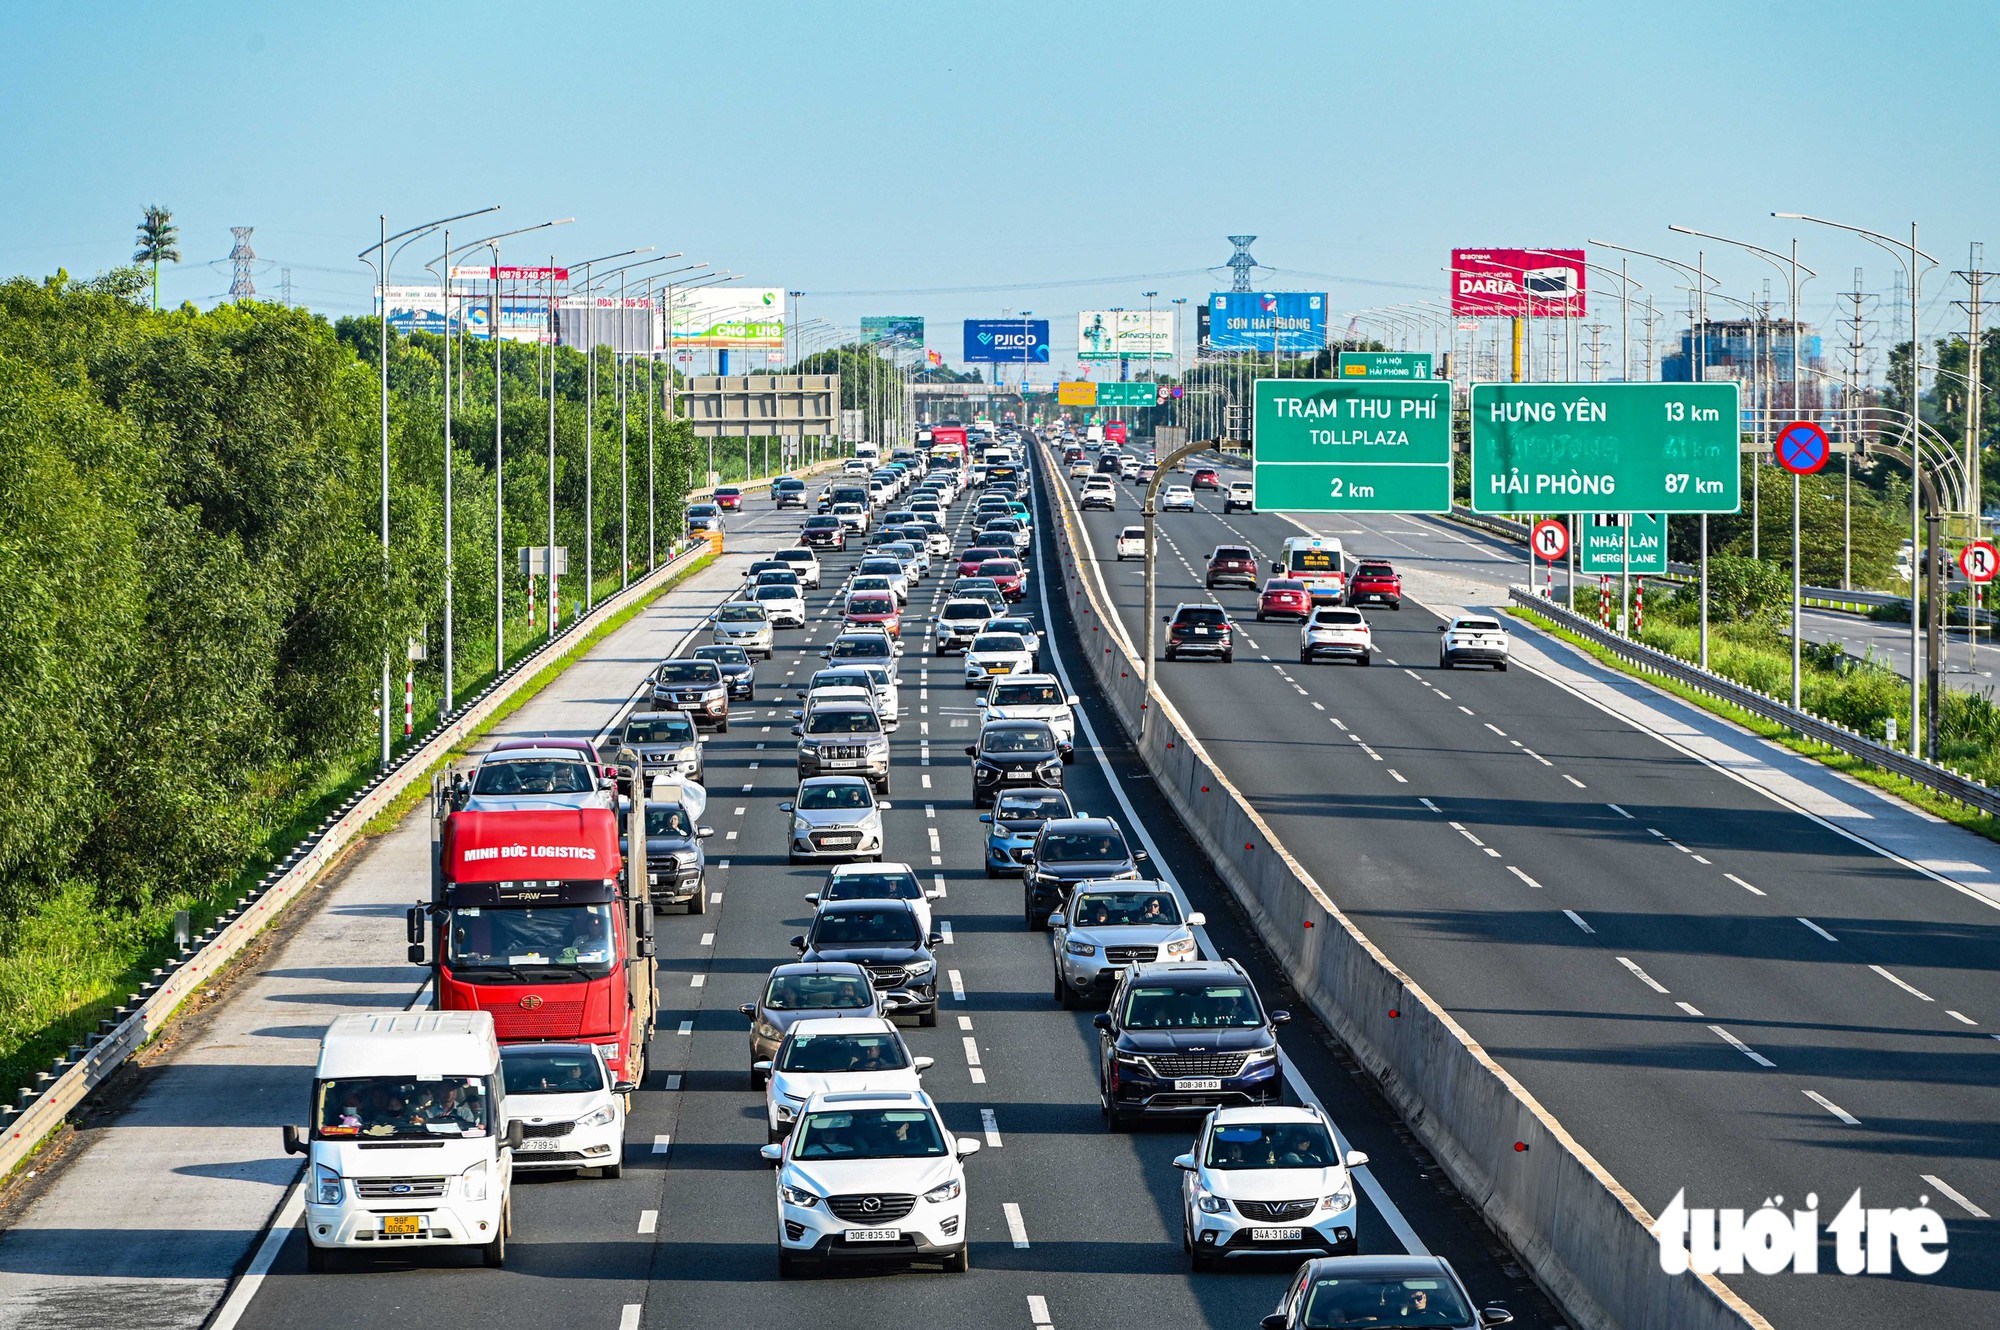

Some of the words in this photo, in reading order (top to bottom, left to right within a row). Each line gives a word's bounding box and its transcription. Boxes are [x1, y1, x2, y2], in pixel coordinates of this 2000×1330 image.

[1460, 280, 1517, 294] DARIA
[1227, 317, 1248, 330] SƠN
[716, 326, 746, 336] CNG
[994, 334, 1036, 346] PJICO
[1389, 358, 1402, 366] NỘI
[1370, 366, 1382, 376] HẢI
[1384, 366, 1409, 376] PHÒNG
[1274, 398, 1337, 422] TRẠM
[1346, 399, 1391, 419] THU
[1401, 394, 1438, 419] PHÍ
[1490, 400, 1556, 422] HƯNG
[1562, 396, 1606, 422] YÊN
[1664, 402, 1684, 421] 13
[1692, 404, 1719, 421] km
[1310, 430, 1409, 446] TOLLPLAZA
[1490, 468, 1529, 494] HẢI
[1536, 469, 1615, 494] PHÒNG
[1664, 474, 1689, 494] 87
[1696, 477, 1724, 494] km
[1330, 478, 1343, 498] 2
[1350, 483, 1374, 498] km
[1630, 532, 1658, 548] LÀN
[1630, 554, 1656, 562] LANE
[464, 848, 498, 862] MINH
[501, 843, 528, 858] ĐỨC
[530, 846, 596, 860] LOGISTICS
[850, 1231, 895, 1240] 30E-835.50
[1254, 1230, 1300, 1239] 34A-318.66
